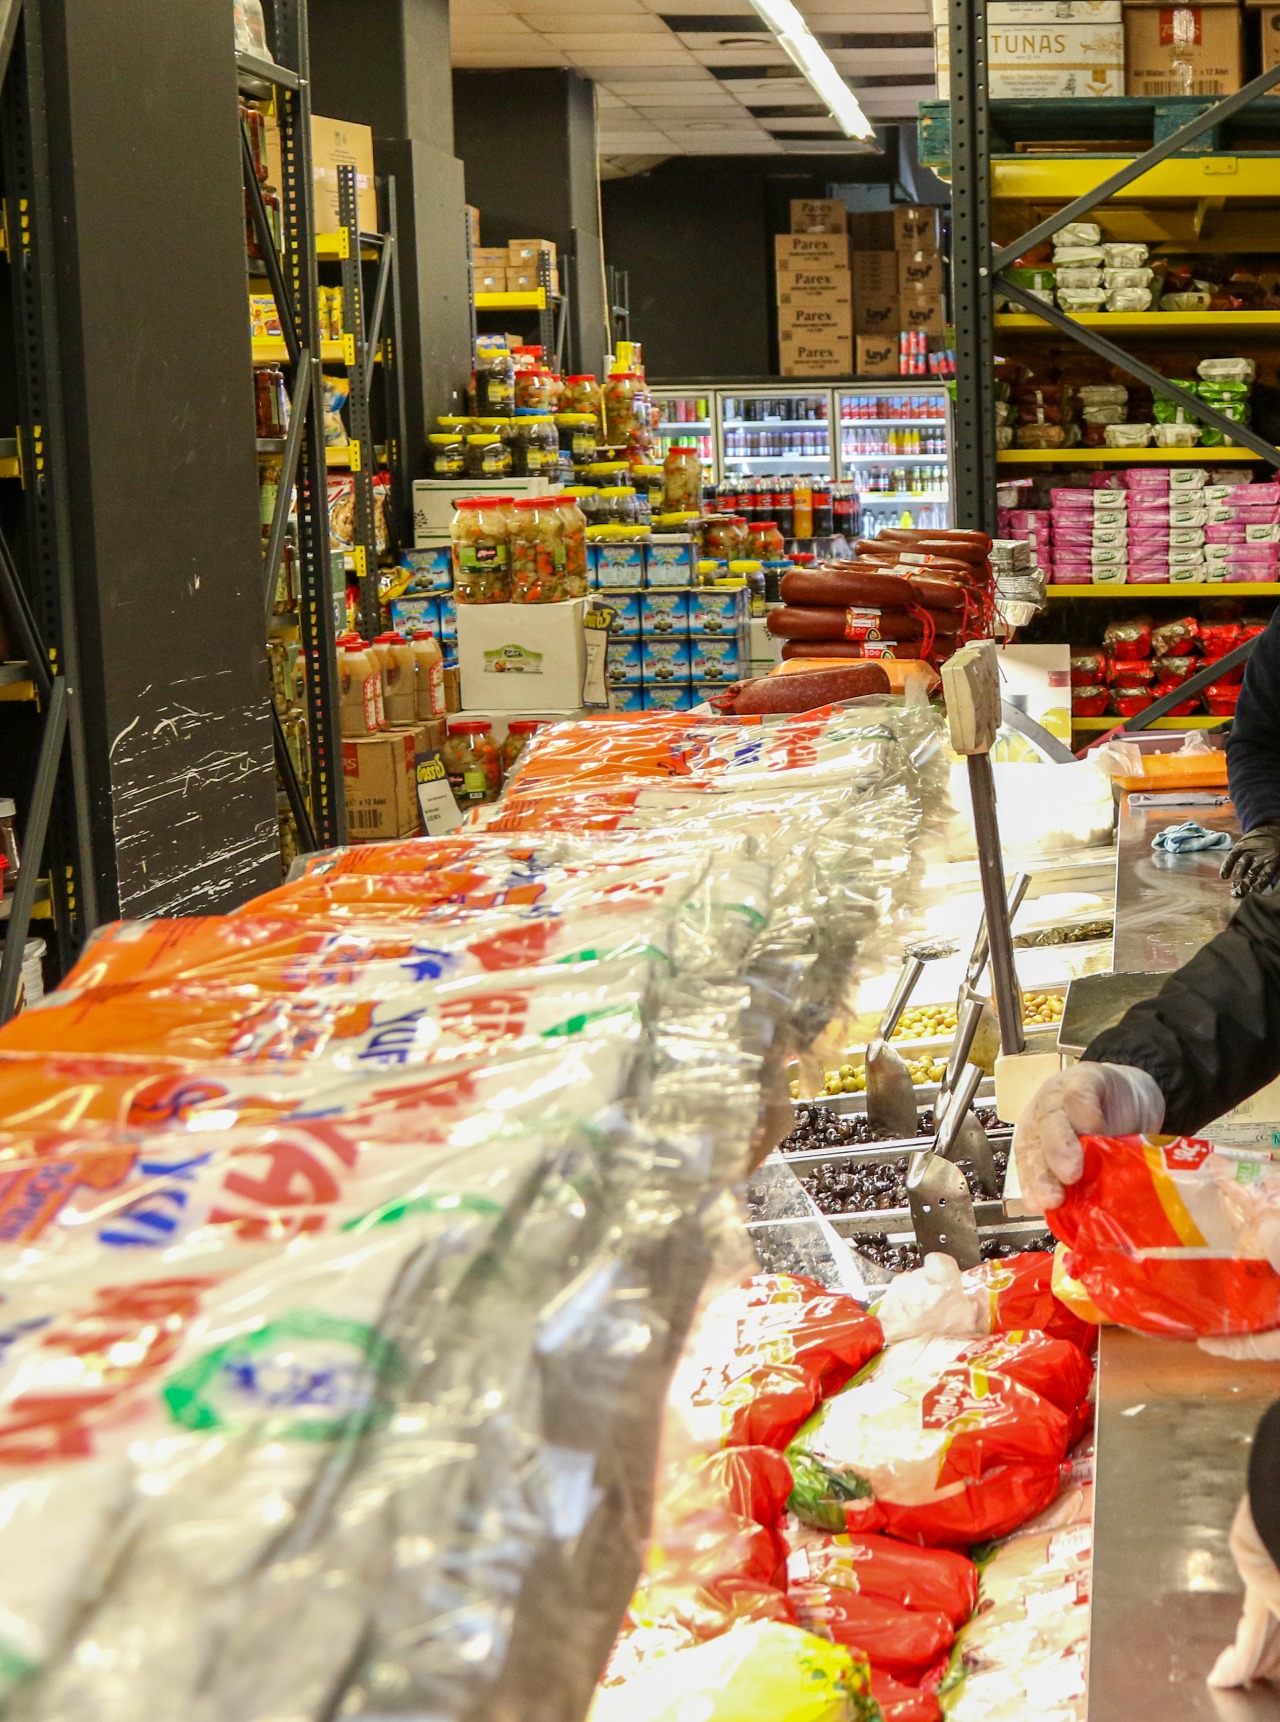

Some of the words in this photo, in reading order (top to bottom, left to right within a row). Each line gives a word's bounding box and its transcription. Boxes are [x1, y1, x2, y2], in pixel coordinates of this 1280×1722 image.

[991, 35, 1066, 53] TUNAS
[793, 239, 830, 249] Parex
[795, 274, 831, 284] Parex
[796, 311, 832, 321] Parex
[798, 347, 834, 357] Parex
